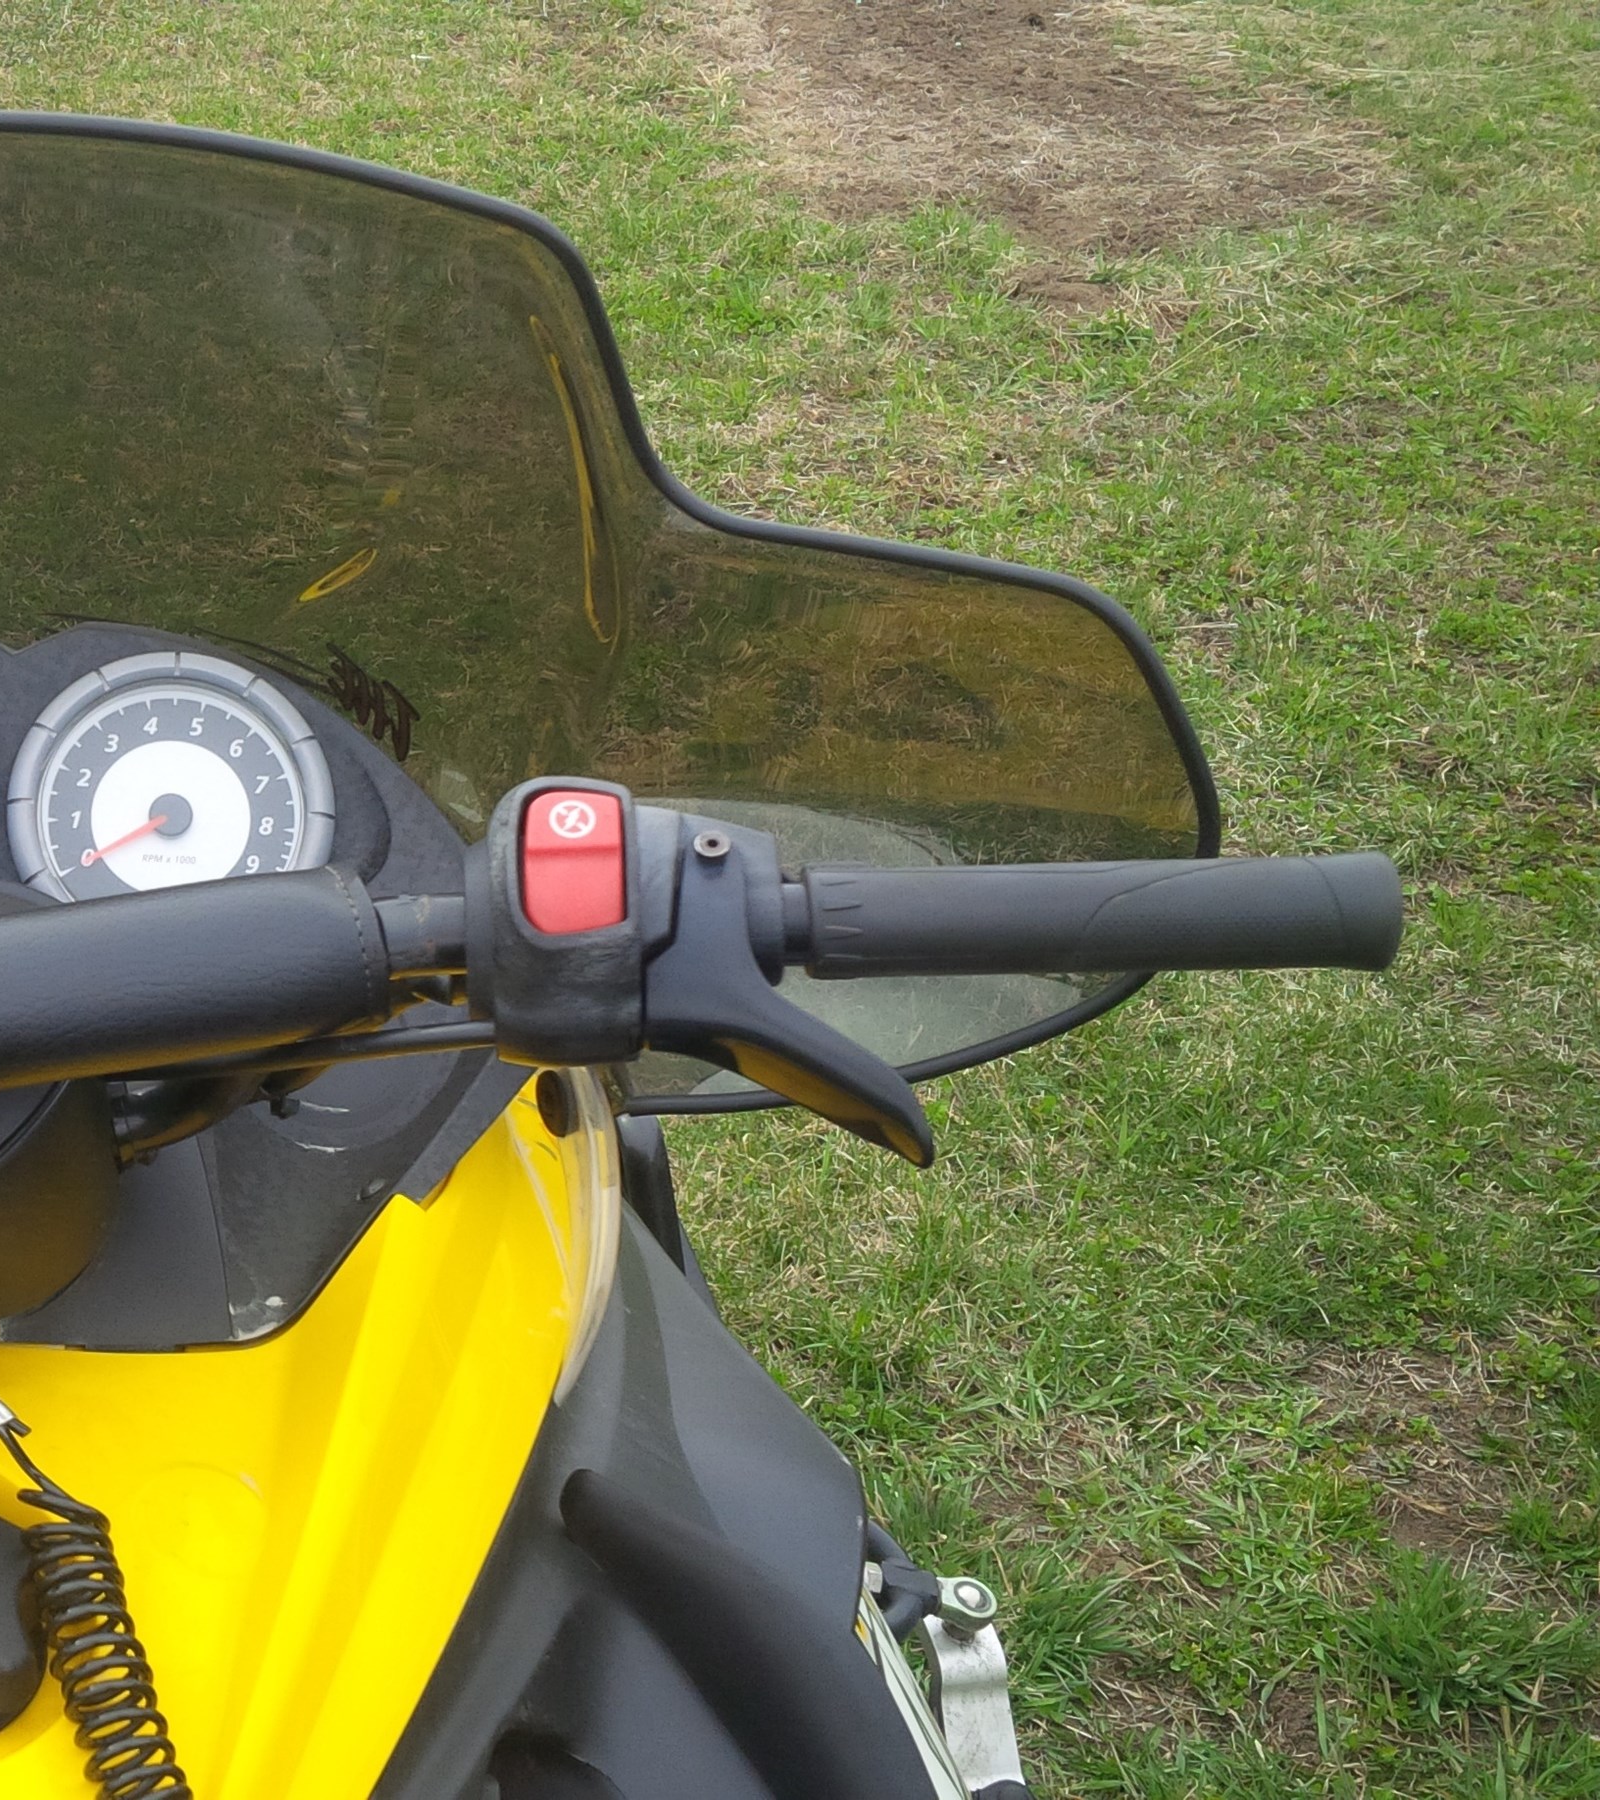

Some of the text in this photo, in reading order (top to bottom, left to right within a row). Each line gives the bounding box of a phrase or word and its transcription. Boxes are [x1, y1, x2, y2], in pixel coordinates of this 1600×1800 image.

[143, 717, 158, 735] 4
[189, 717, 204, 736] 5
[104, 734, 119, 752] 3
[229, 738, 244, 758] 6
[76, 768, 92, 787] 2
[255, 776, 270, 794] 7
[71, 810, 81, 829] 1
[259, 817, 274, 836] 8
[81, 849, 96, 867] 0
[142, 854, 163, 863] RPM
[176, 855, 197, 865] 1000
[245, 855, 260, 874] 9
